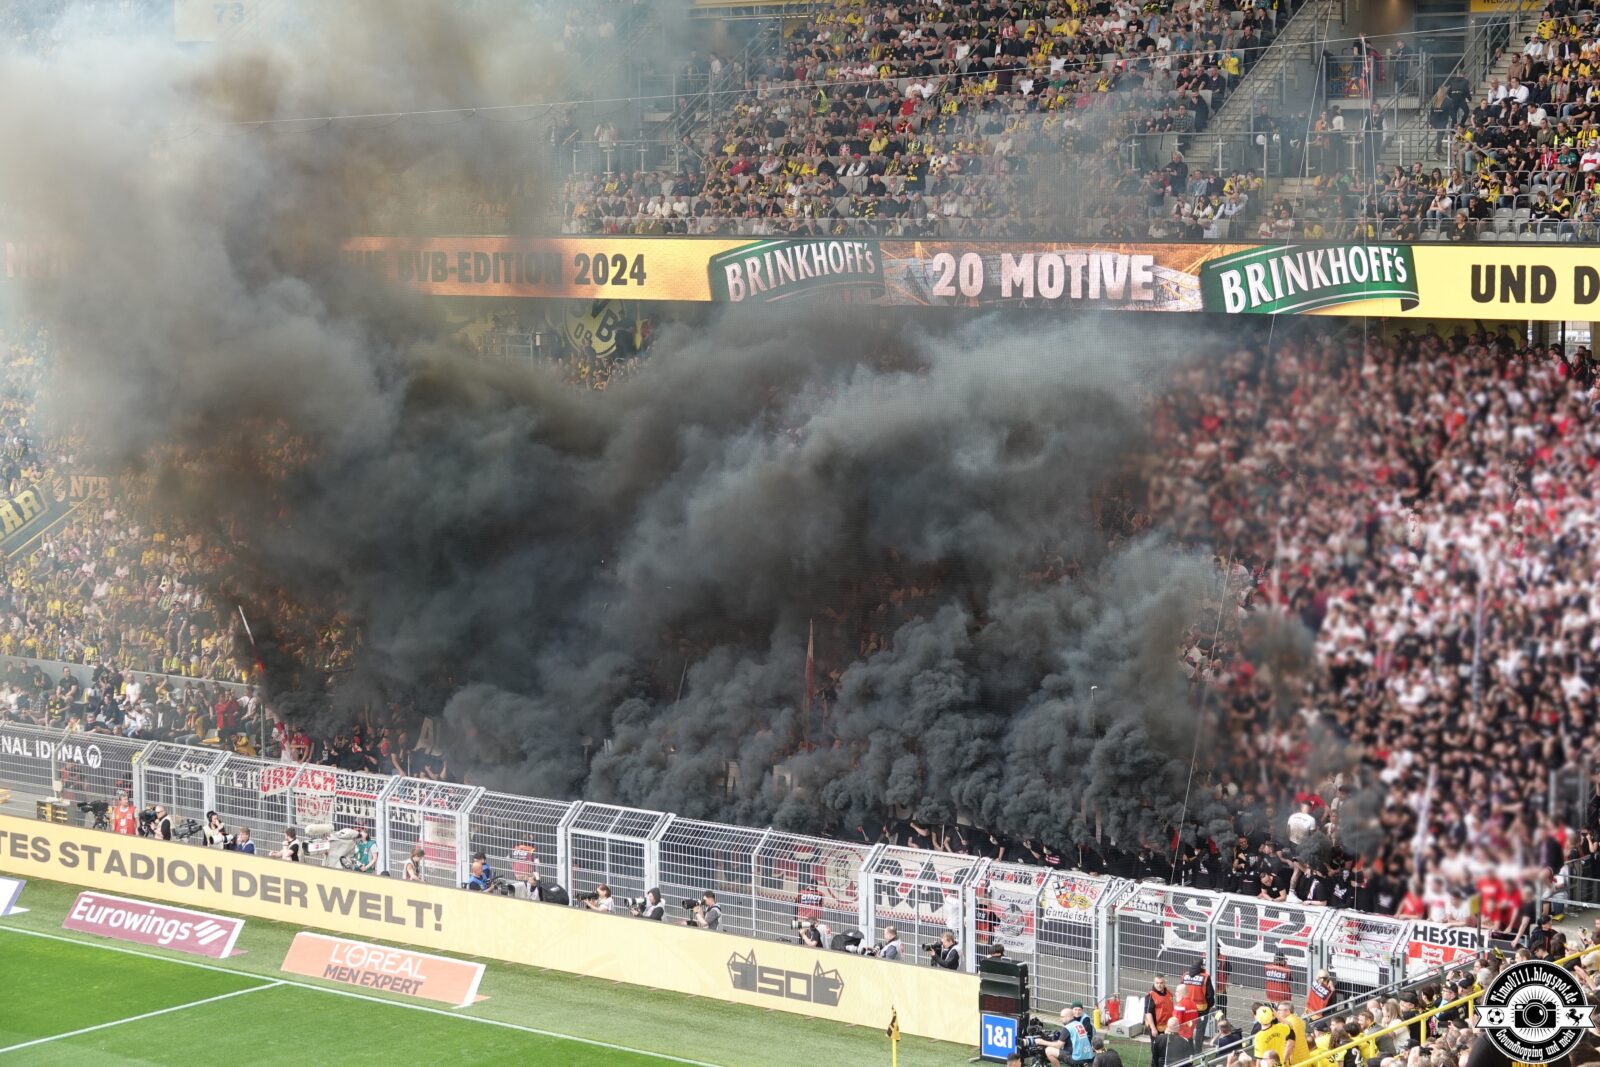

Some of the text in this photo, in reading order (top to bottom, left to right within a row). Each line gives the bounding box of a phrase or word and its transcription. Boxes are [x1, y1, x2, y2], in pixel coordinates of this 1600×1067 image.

[213, 2, 245, 25] 73
[398, 251, 566, 285] BVB-EDITION
[574, 252, 647, 286] 2024
[724, 241, 876, 302] BRINKHOFF's
[932, 252, 1154, 300] 20 MOTIVE
[1220, 246, 1408, 313] BRINKHOFF's
[1470, 264, 1557, 304] UND
[0, 489, 43, 540] AR
[58, 841, 223, 893] STADION
[232, 869, 309, 908] DER
[316, 883, 443, 932] WELT!
[71, 897, 193, 945] Eurowings
[1413, 924, 1485, 949] HESSEN
[323, 964, 424, 995] MEN EXPERT
[330, 943, 427, 979] L'ORÉAL
[1184, 974, 1204, 982] aas
[985, 1023, 1014, 1049] 1&1
